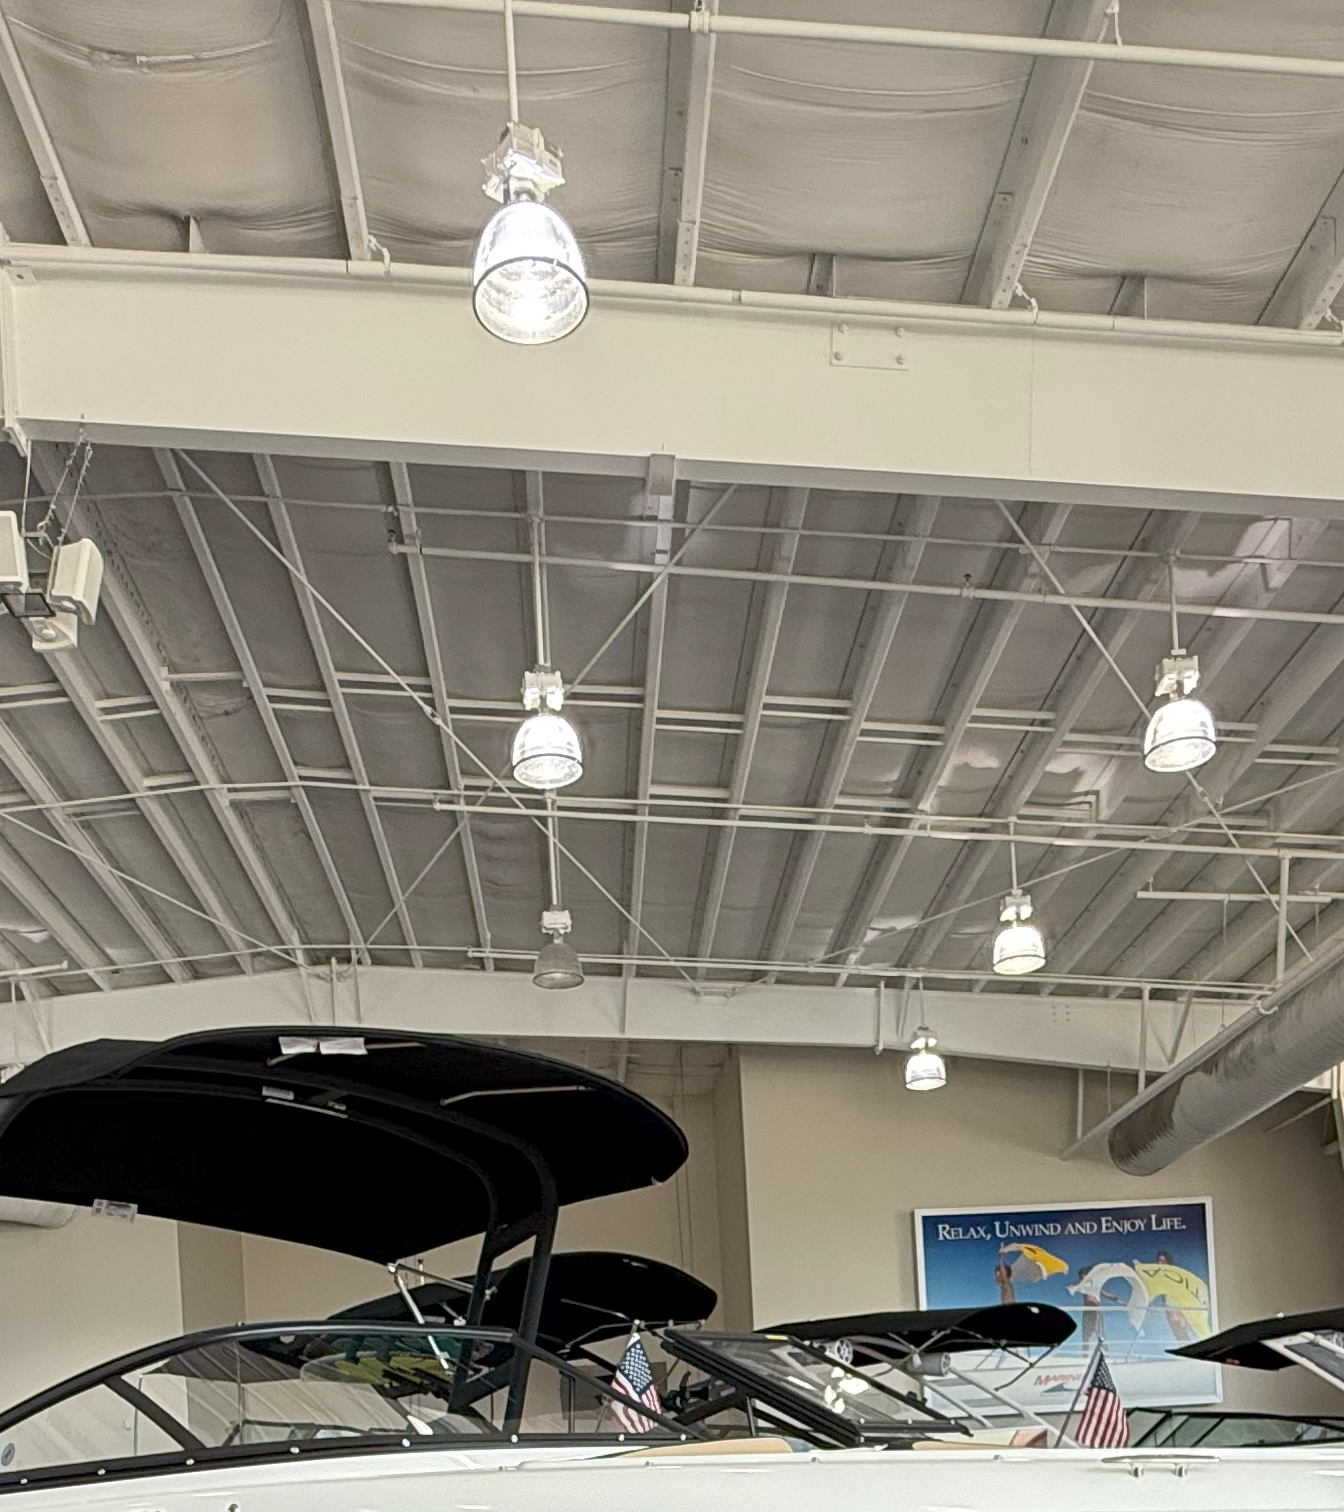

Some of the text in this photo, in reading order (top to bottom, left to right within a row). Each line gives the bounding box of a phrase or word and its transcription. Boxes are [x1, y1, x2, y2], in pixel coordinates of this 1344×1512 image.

[937, 1213, 1188, 1241] RELAX, UNWIND AND ENJOY LIFE.
